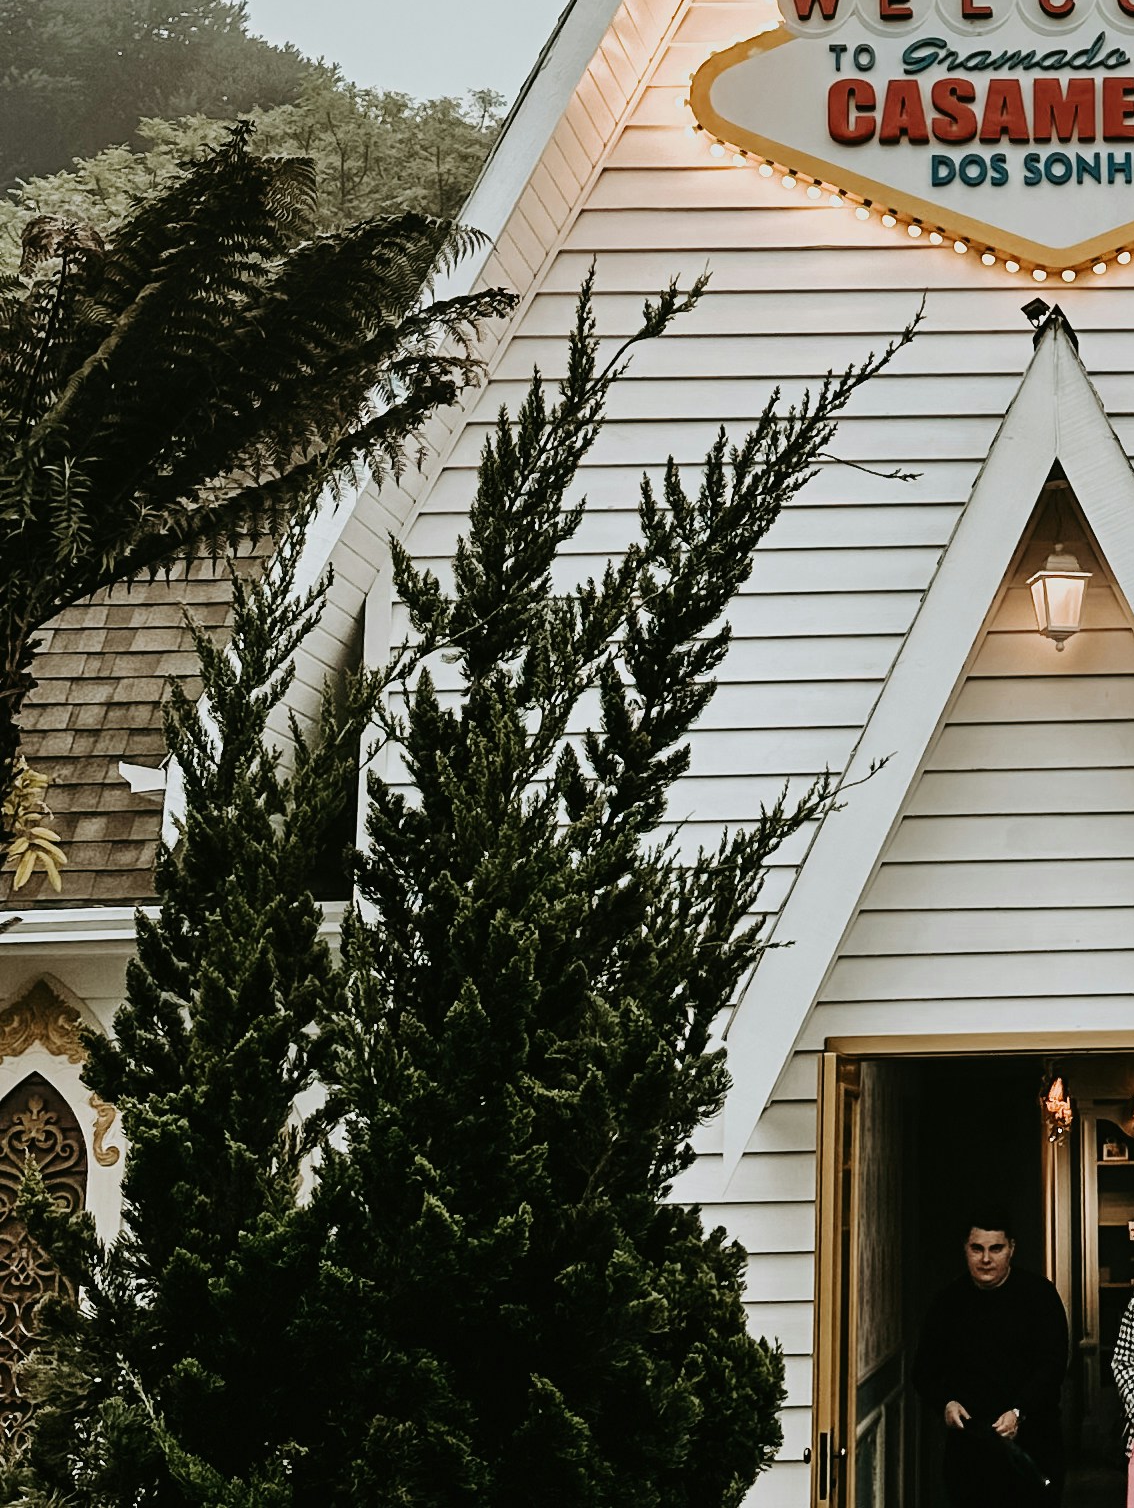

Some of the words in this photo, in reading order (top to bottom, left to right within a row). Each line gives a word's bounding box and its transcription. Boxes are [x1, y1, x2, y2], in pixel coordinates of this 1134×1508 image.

[828, 44, 876, 72] TO
[901, 31, 1131, 74] Gramado
[931, 153, 1009, 187] DOS
